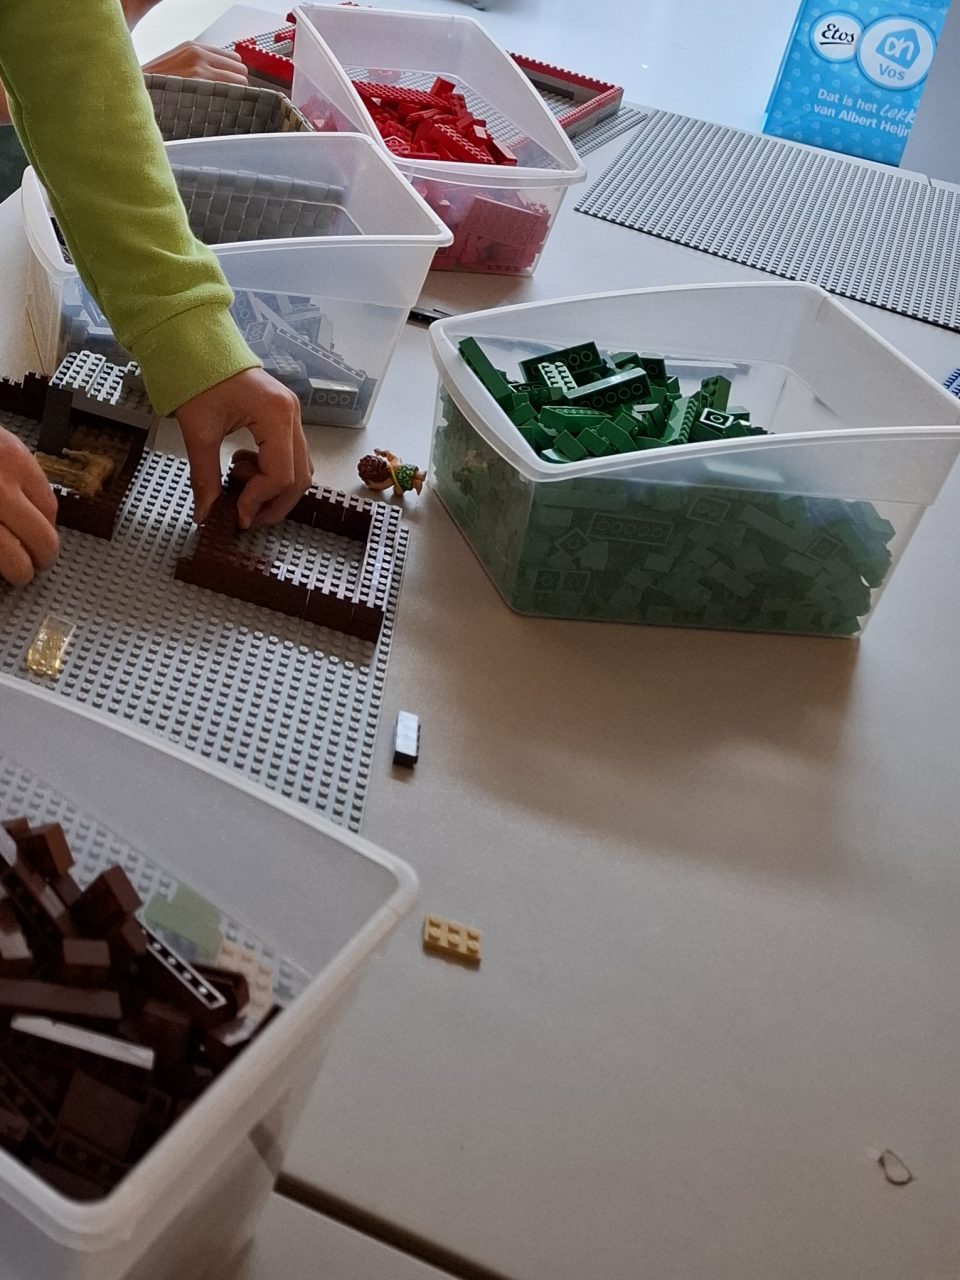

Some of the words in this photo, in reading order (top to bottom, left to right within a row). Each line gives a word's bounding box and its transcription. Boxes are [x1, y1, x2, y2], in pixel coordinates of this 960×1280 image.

[821, 23, 855, 43] Etos
[817, 88, 840, 103] Dat
[842, 94, 854, 106] is
[856, 98, 878, 113] het
[814, 104, 836, 118] van
[838, 110, 877, 128] Albert
